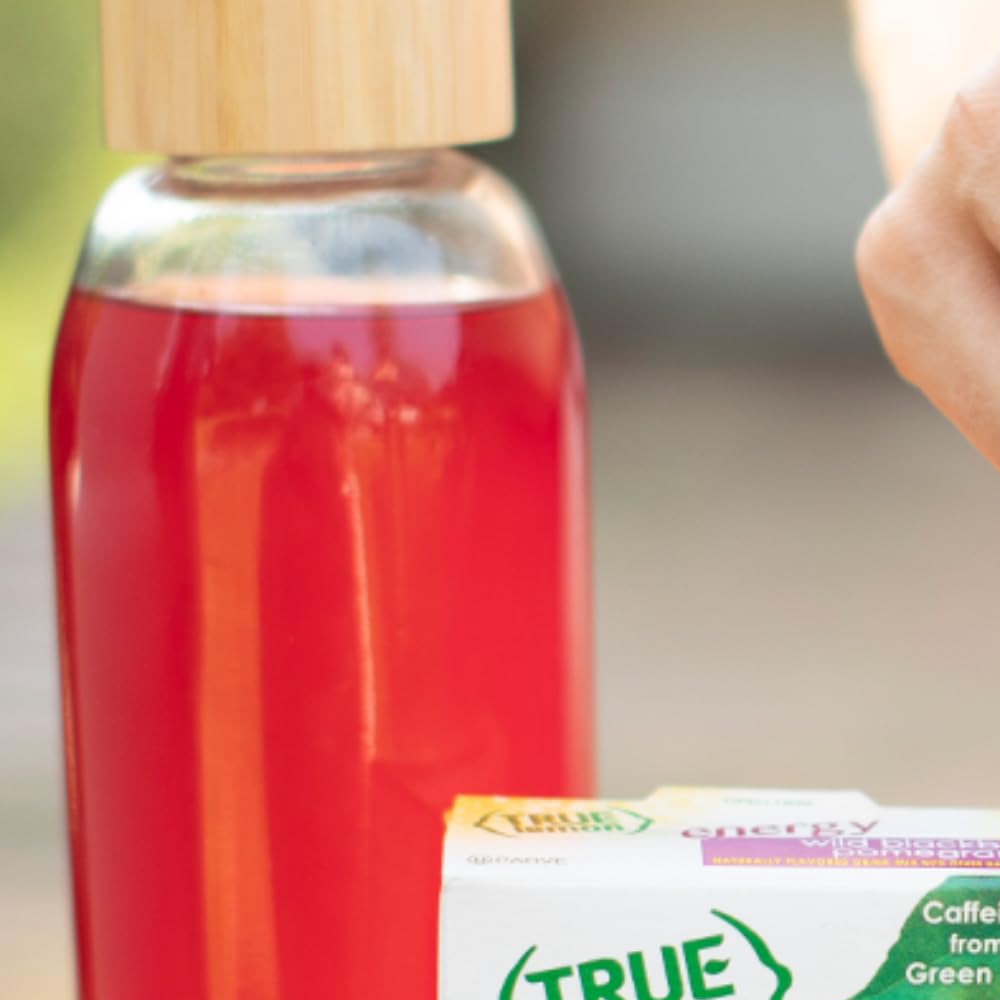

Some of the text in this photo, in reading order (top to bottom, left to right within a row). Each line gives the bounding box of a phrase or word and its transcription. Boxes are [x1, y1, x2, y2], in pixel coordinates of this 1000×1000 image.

[501, 811, 618, 832] TRUE
[681, 820, 880, 838] energy
[905, 961, 993, 986] Green
